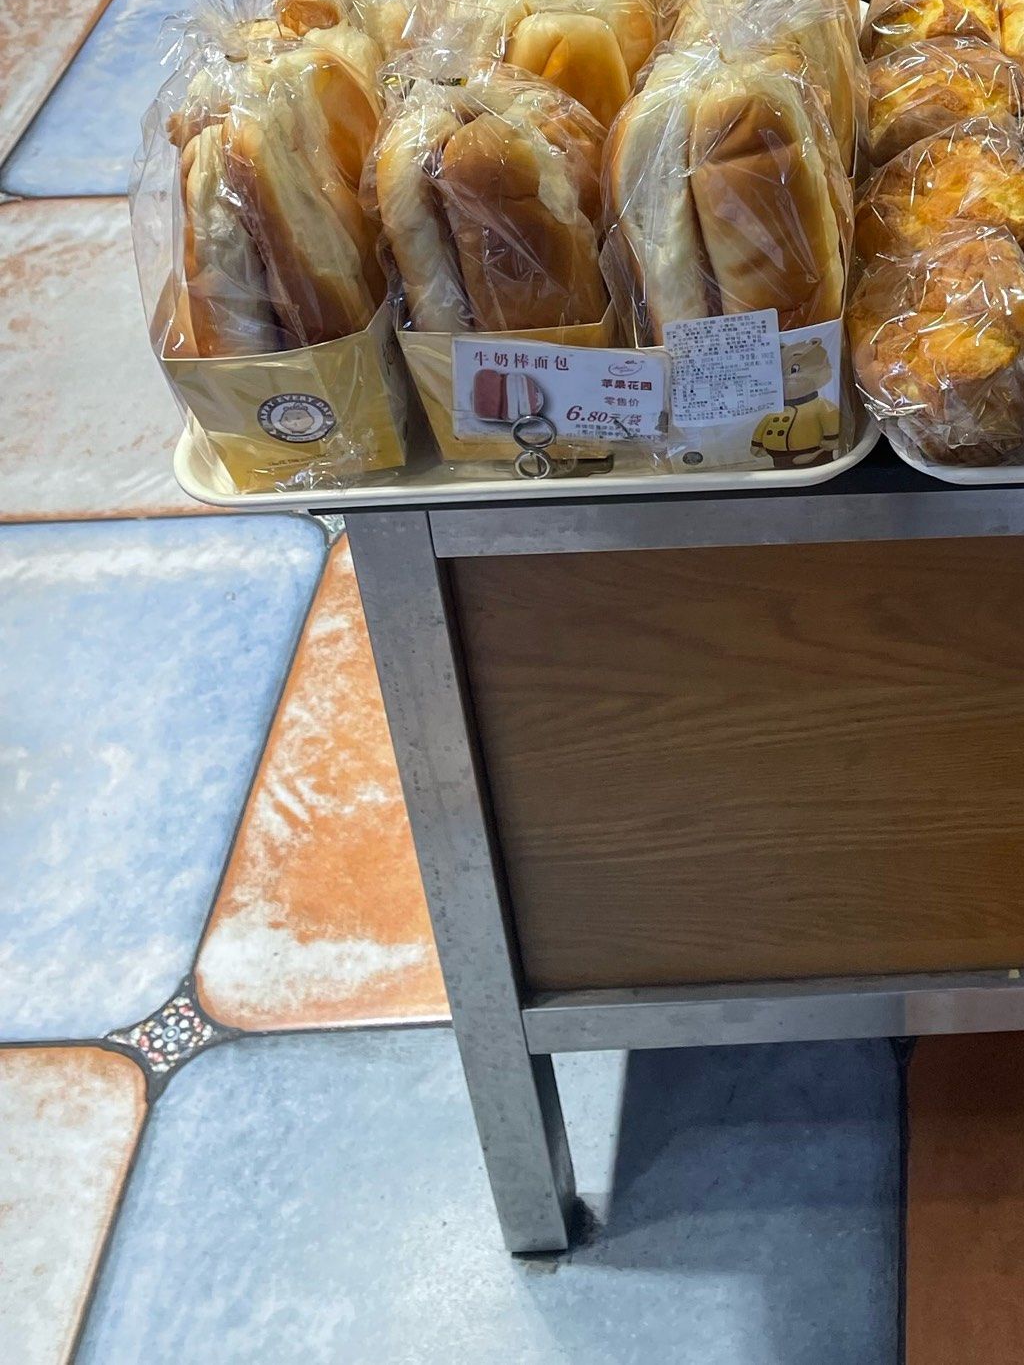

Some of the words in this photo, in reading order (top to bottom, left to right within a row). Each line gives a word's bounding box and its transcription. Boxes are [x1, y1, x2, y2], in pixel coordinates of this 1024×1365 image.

[474, 351, 569, 371] 牛奶棒面包
[600, 379, 652, 391] 苹果花园
[604, 396, 640, 408] 零售价
